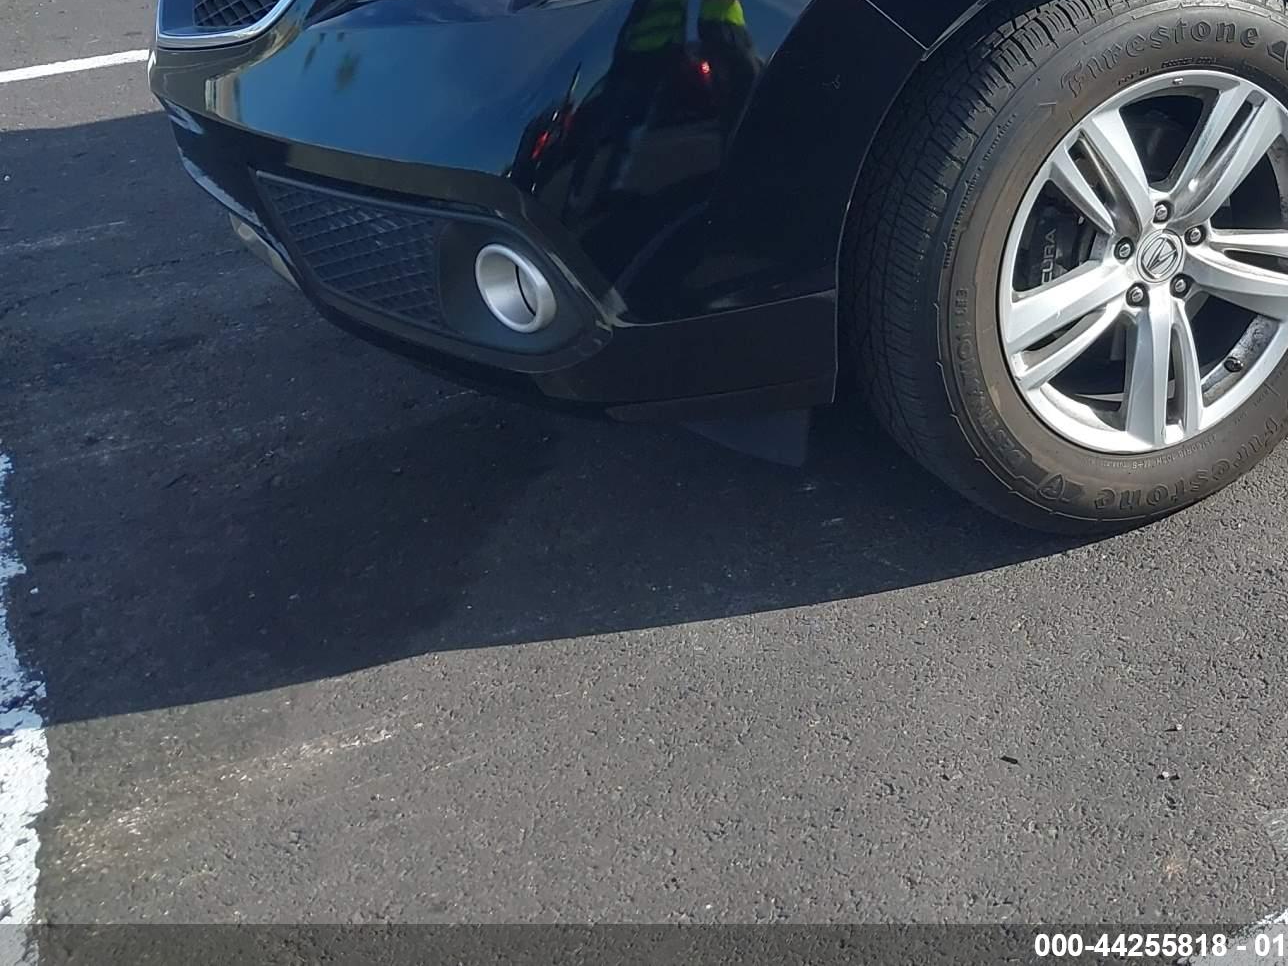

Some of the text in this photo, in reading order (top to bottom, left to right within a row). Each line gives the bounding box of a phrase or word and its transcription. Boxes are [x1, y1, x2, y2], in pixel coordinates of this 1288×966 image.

[1060, 18, 1260, 98] Firestone
[1041, 228, 1057, 284] CURA
[1093, 416, 1284, 510] Firestone
